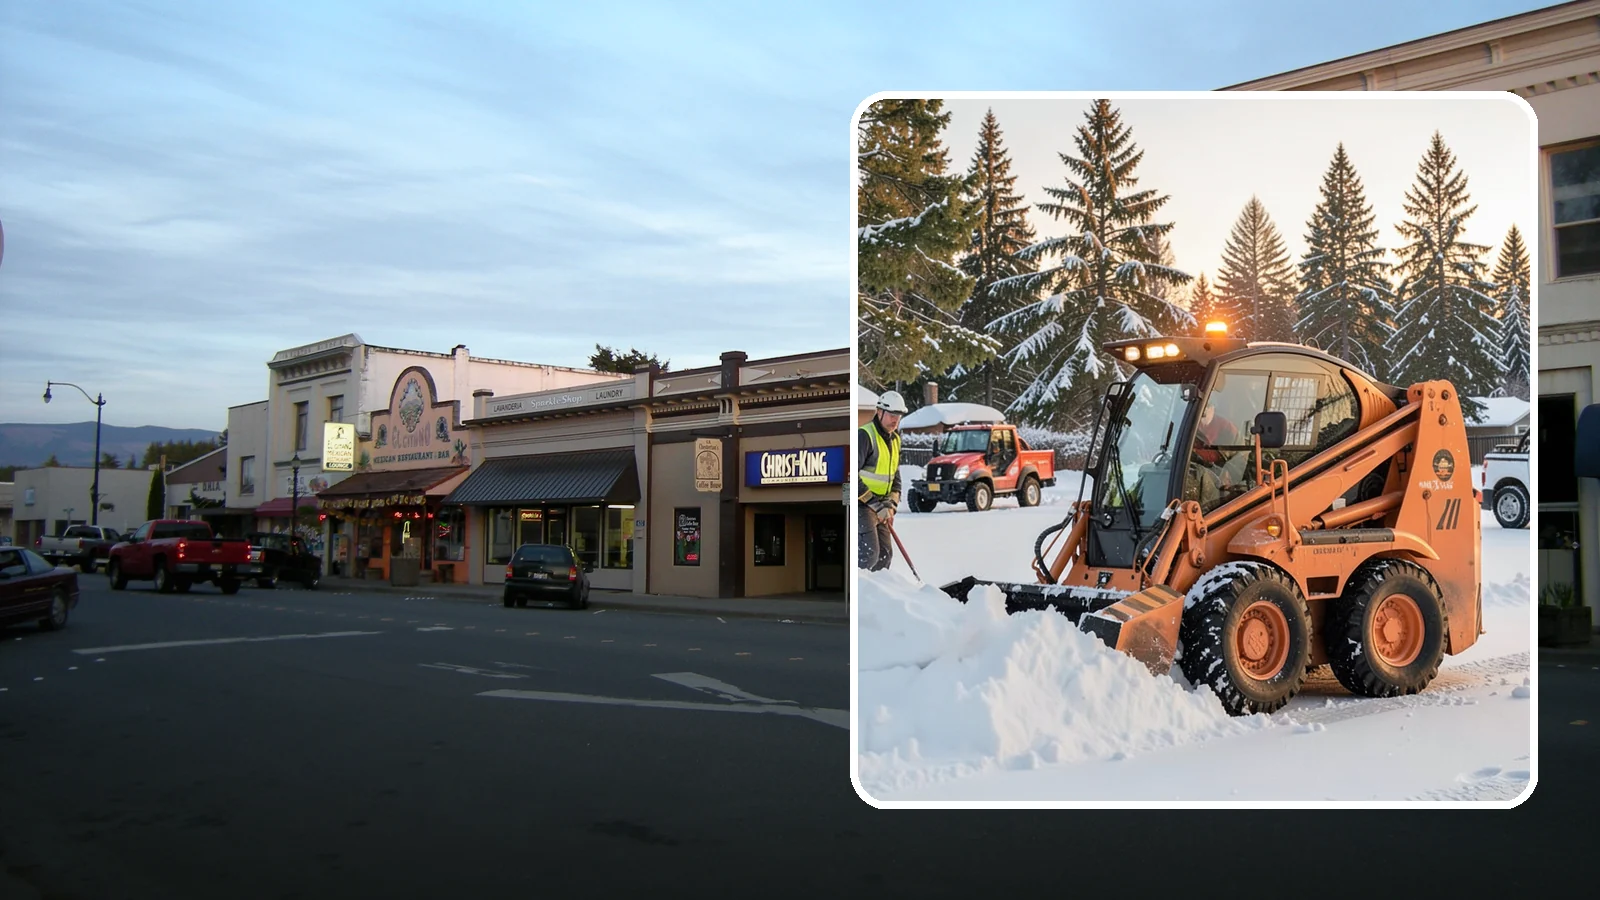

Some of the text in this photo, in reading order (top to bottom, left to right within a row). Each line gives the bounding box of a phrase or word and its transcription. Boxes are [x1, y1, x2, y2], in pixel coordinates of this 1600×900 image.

[562, 394, 582, 404] Shop
[595, 388, 623, 400] LAUNDRY
[493, 402, 522, 413] LAVANDERIA
[374, 455, 396, 464] MEXICAN
[397, 451, 433, 462] RESTAURANT
[437, 450, 450, 459] BAR
[799, 450, 827, 476] KING
